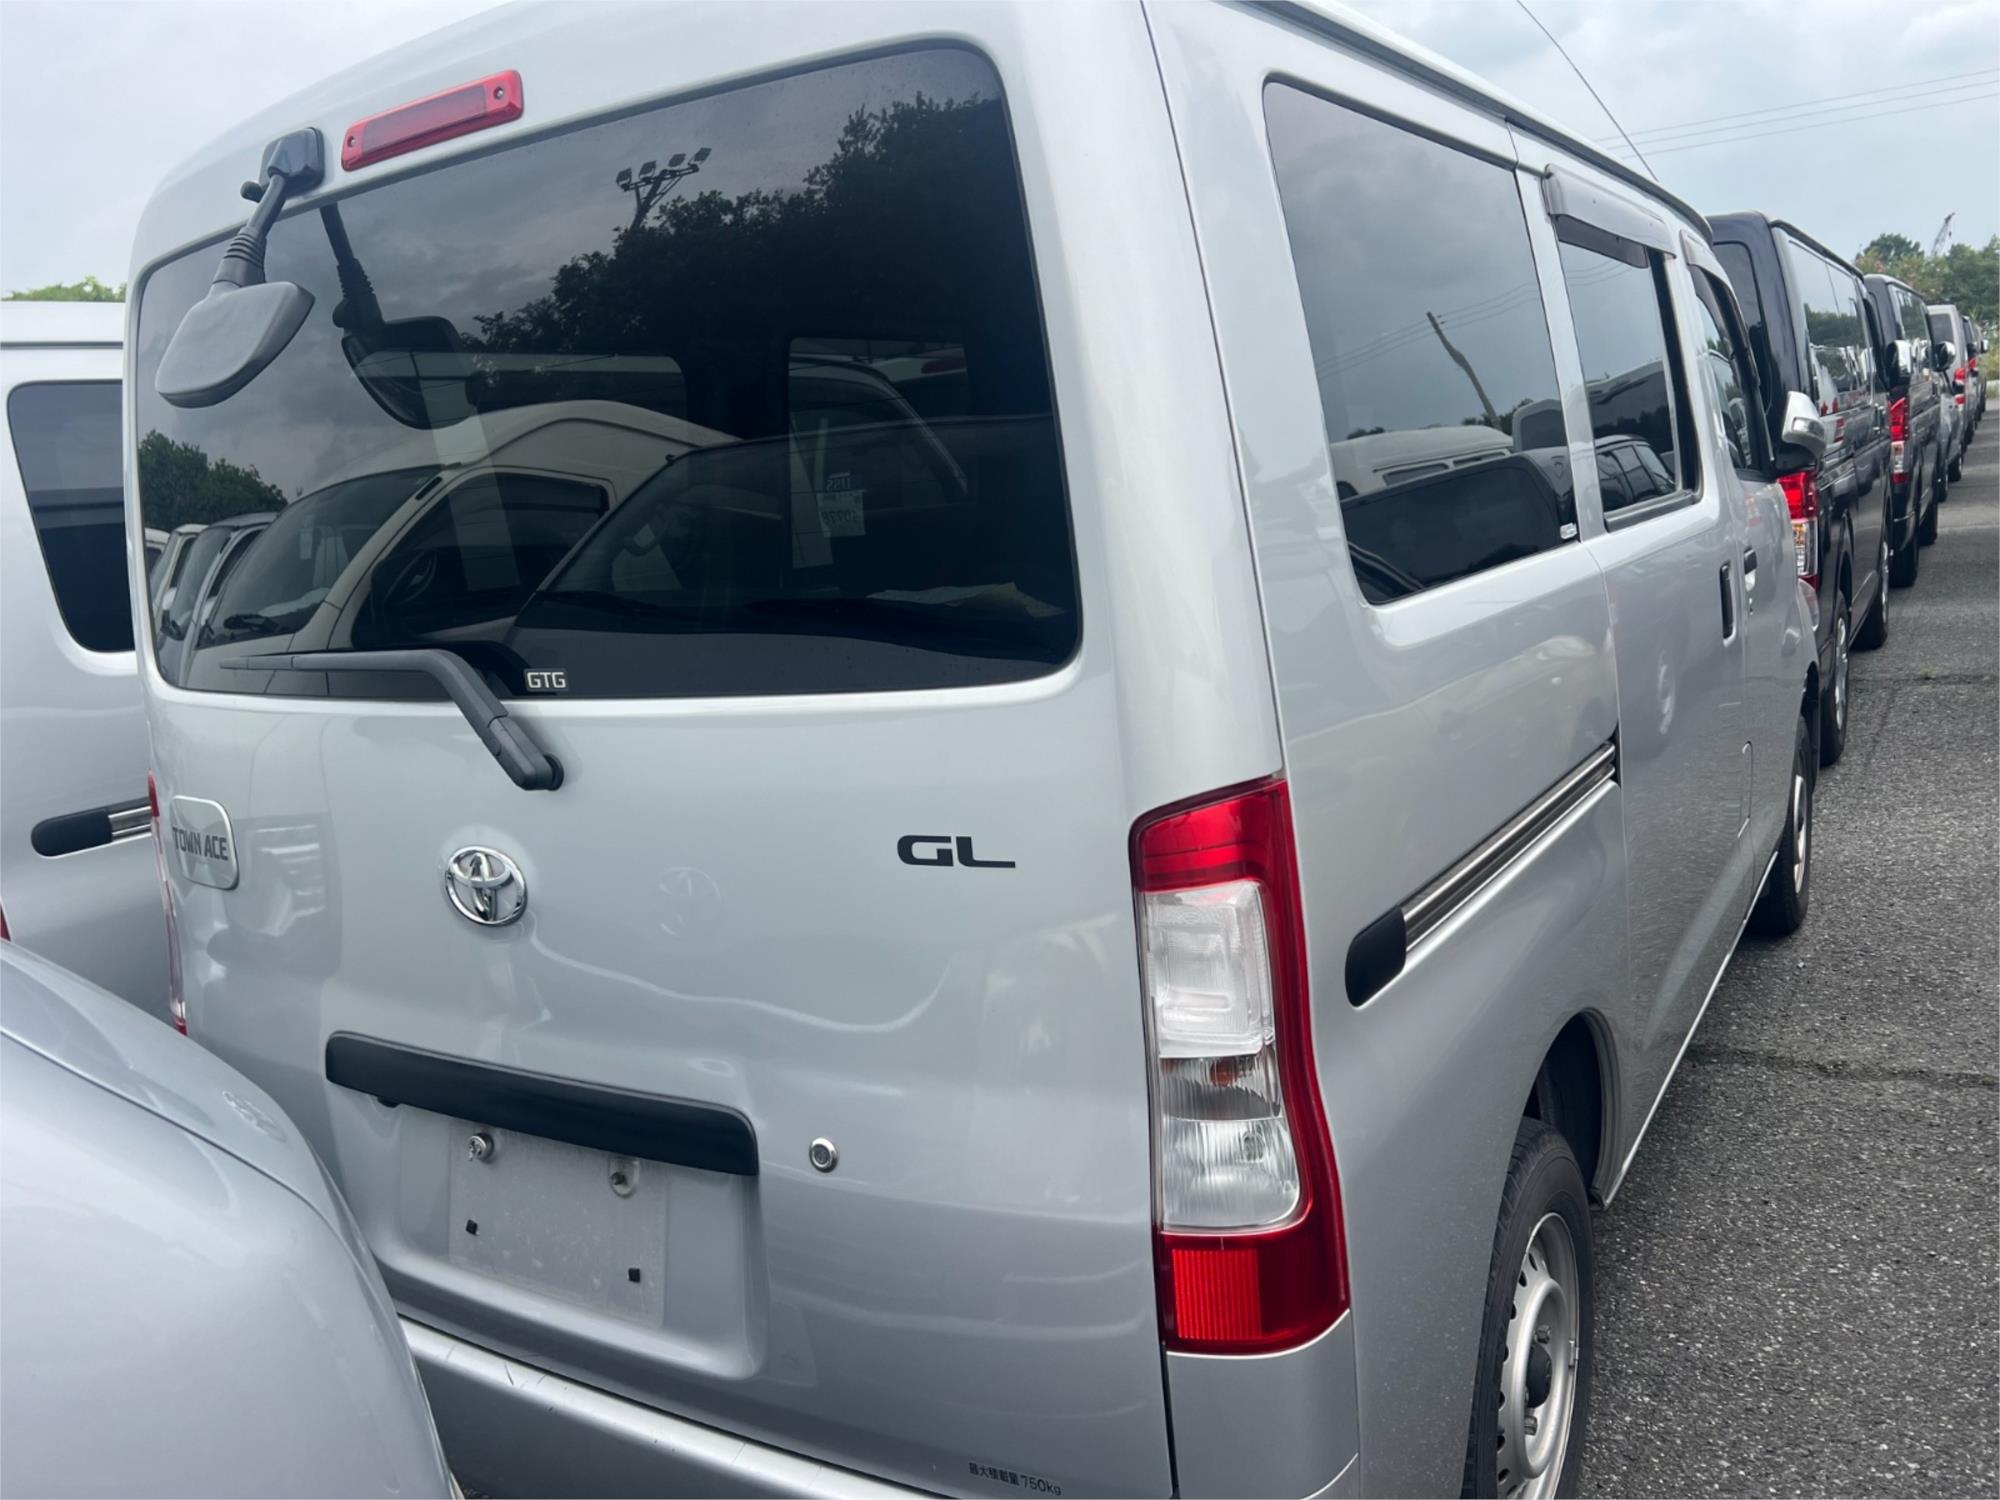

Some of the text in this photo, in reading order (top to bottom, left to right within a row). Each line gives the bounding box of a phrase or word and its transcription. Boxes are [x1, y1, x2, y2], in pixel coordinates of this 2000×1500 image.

[527, 671, 566, 689] GTG
[172, 826, 229, 861] TOWN ACE
[897, 834, 1016, 868] GL
